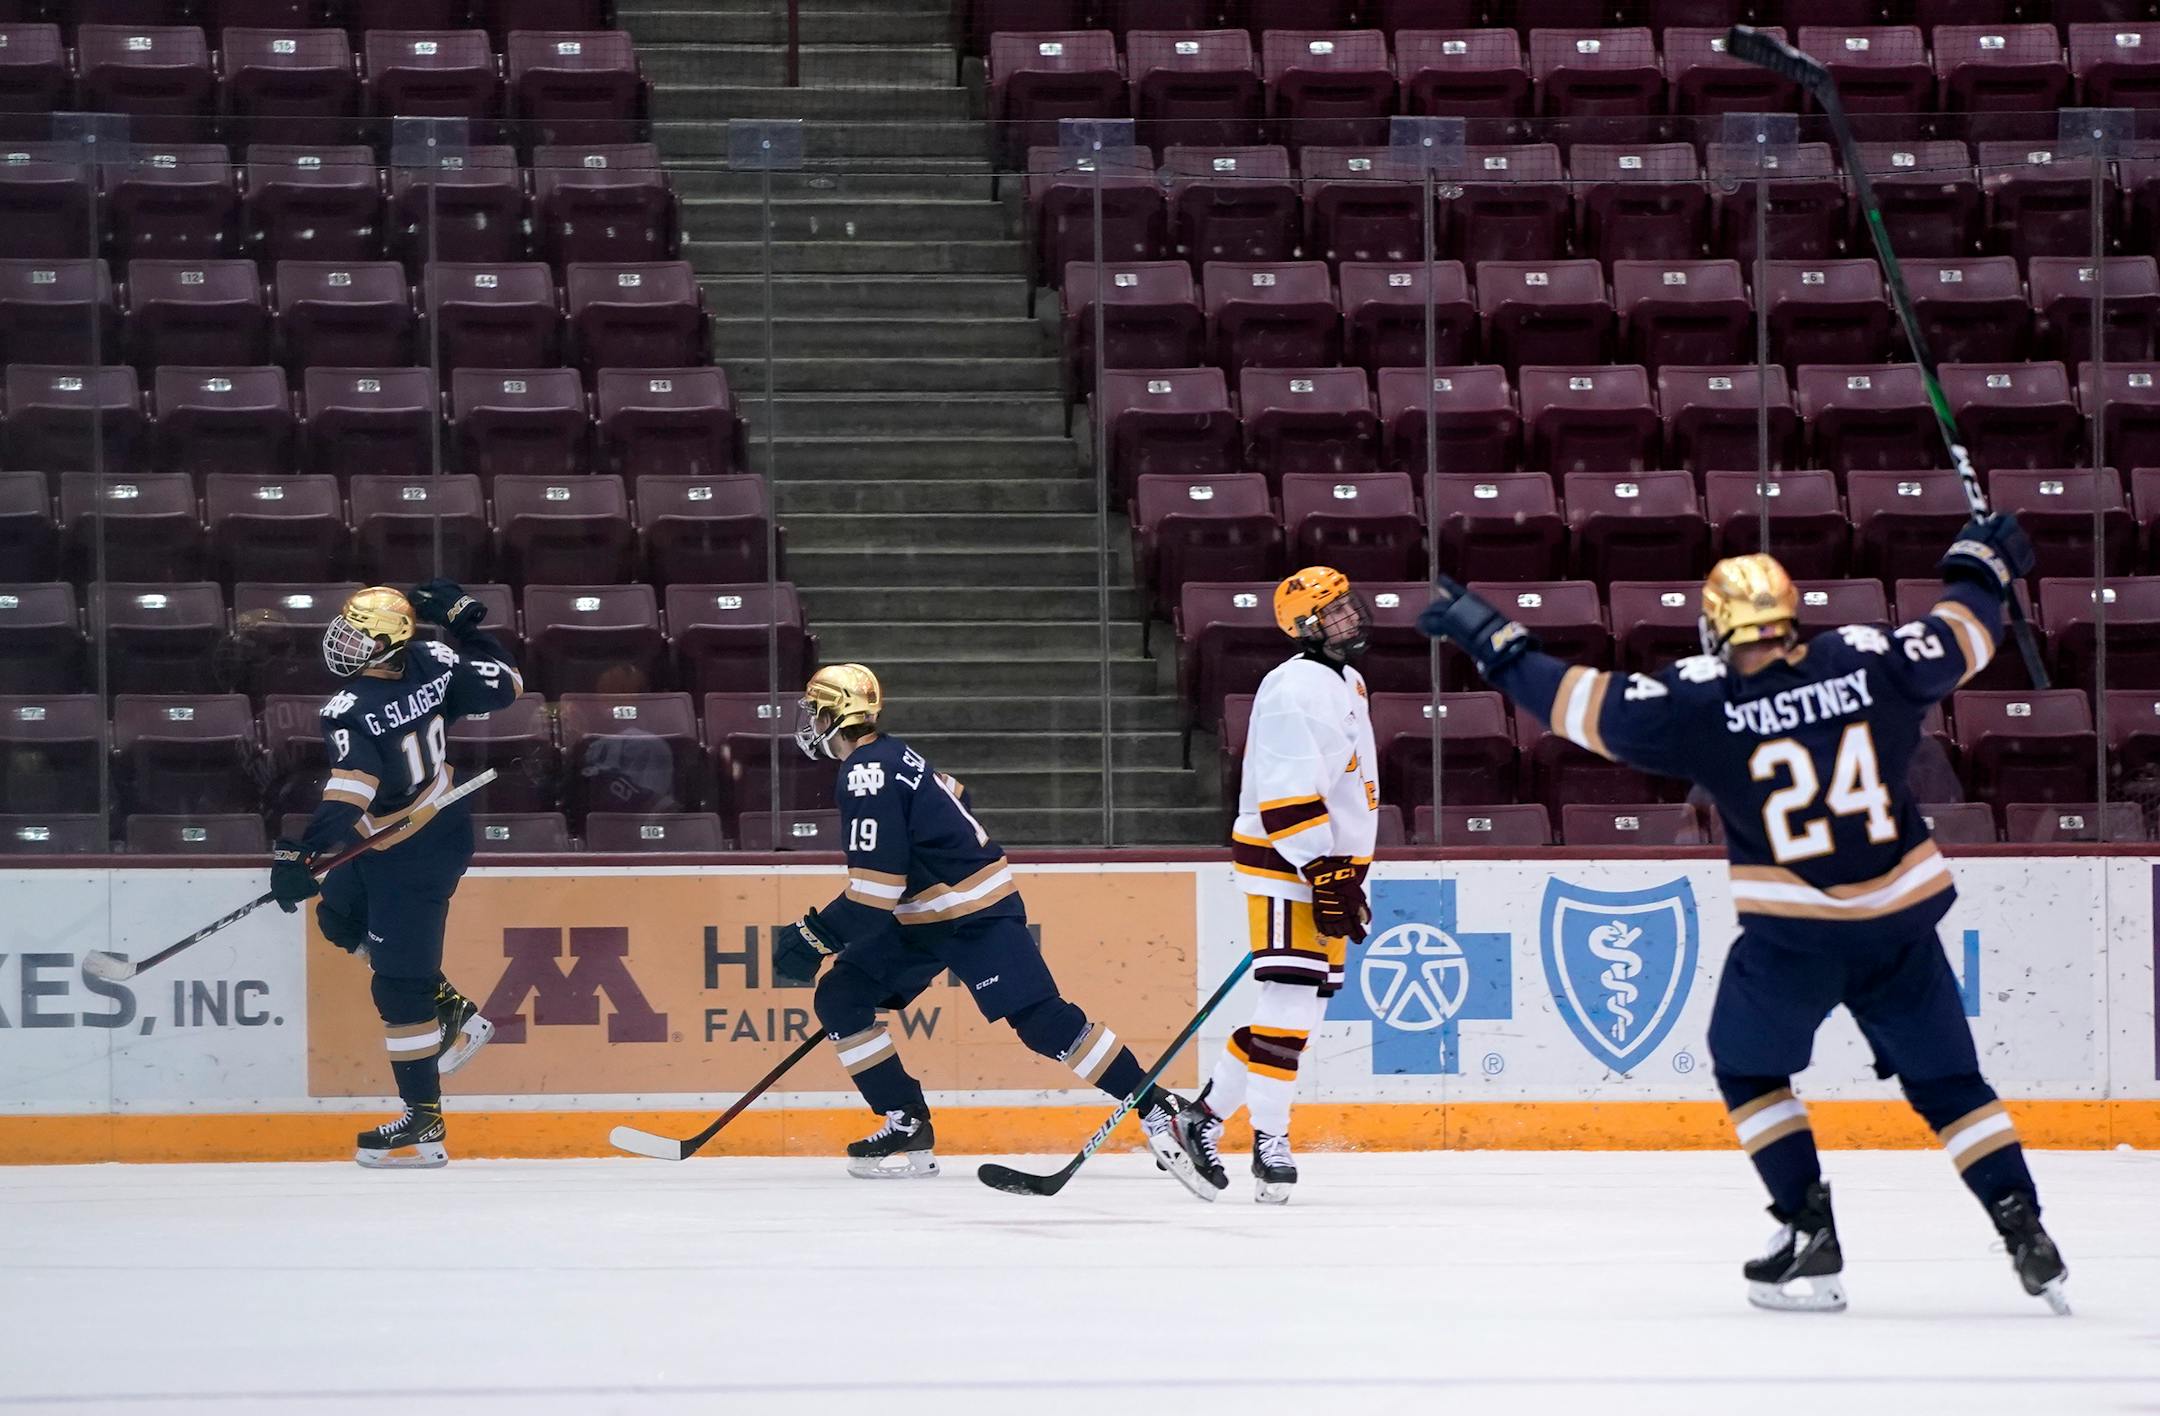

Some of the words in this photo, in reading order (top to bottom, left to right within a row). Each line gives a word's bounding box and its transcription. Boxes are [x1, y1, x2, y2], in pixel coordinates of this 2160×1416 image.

[1725, 668, 1873, 735] STASTNEY
[365, 712, 387, 737] G.
[1748, 721, 1898, 864] 24
[848, 818, 878, 852] 19
[1313, 867, 1357, 887] CC
[0, 952, 157, 1036] ES,
[174, 980, 284, 1027] INC.
[476, 926, 668, 1044] M
[975, 974, 1000, 991] CCM
[704, 1007, 942, 1042] FAIRW
